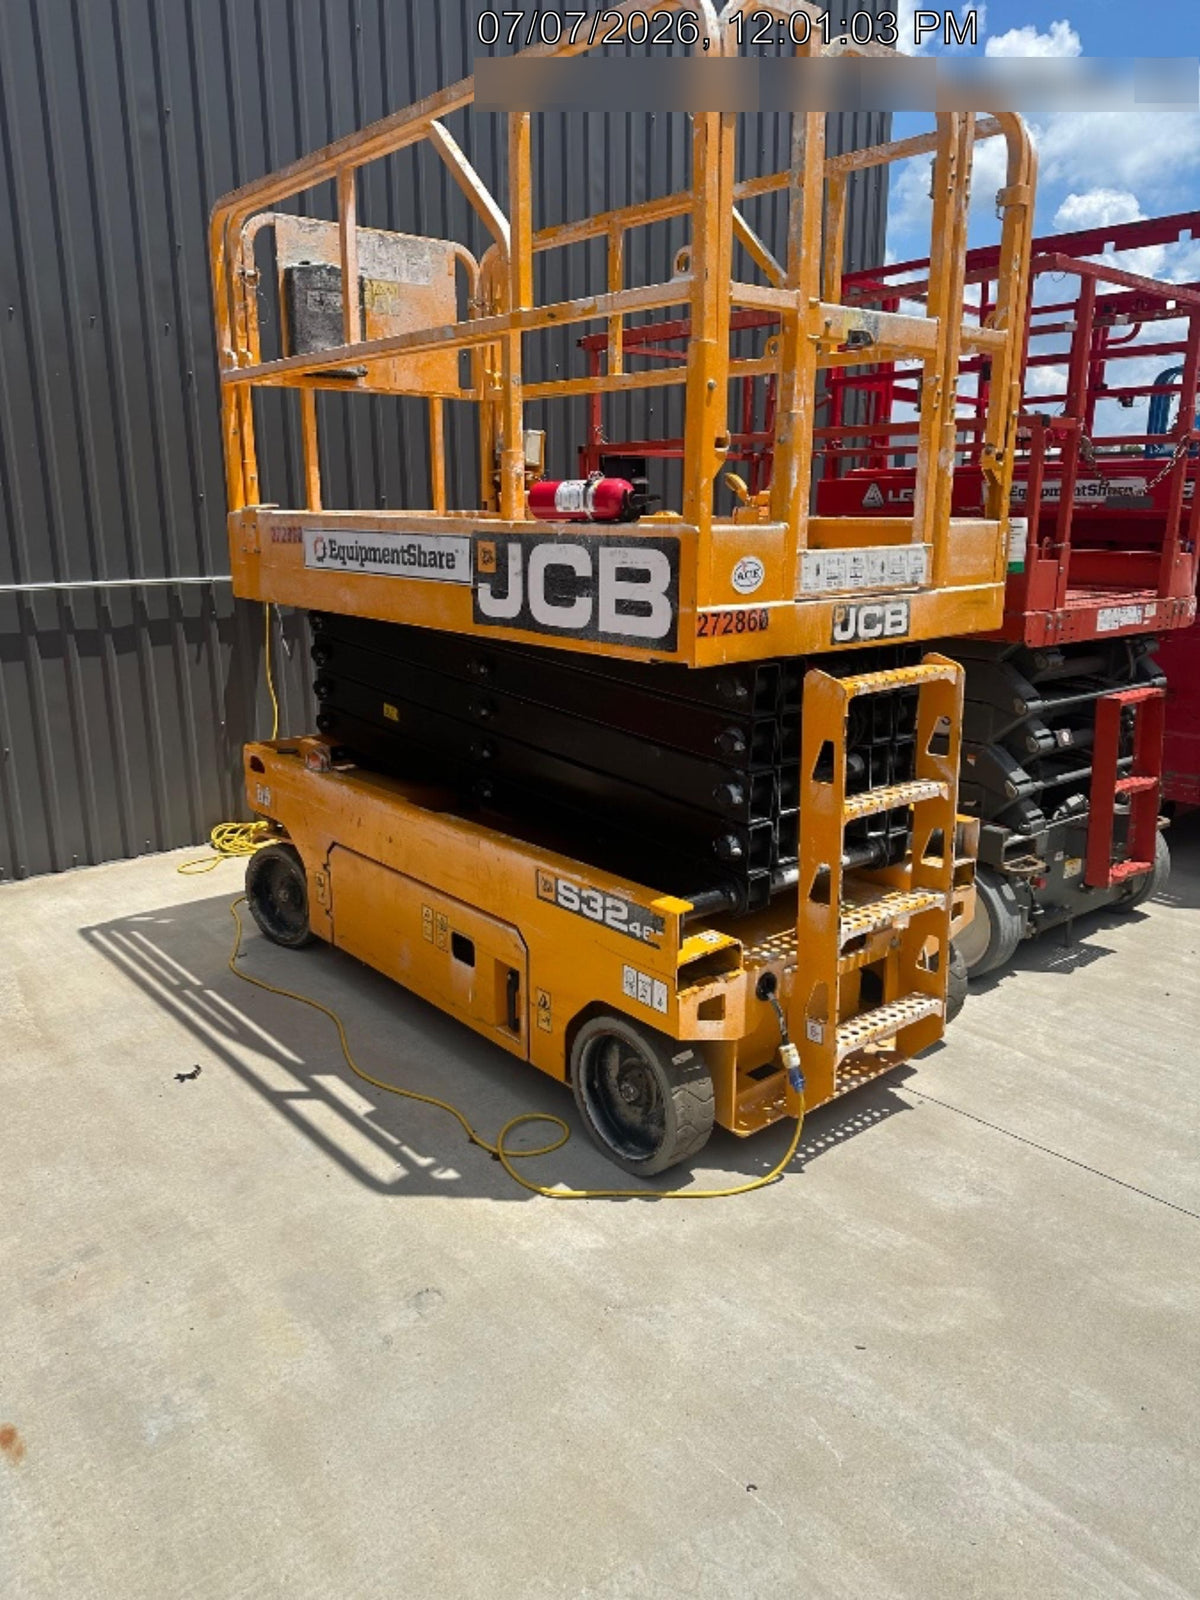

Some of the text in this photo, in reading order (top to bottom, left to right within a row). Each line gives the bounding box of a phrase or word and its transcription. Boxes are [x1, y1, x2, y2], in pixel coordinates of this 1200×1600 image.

[328, 539, 456, 569] EquipmentShare
[477, 542, 672, 639] JCB
[697, 608, 769, 637] 272860
[833, 602, 908, 641] JCB
